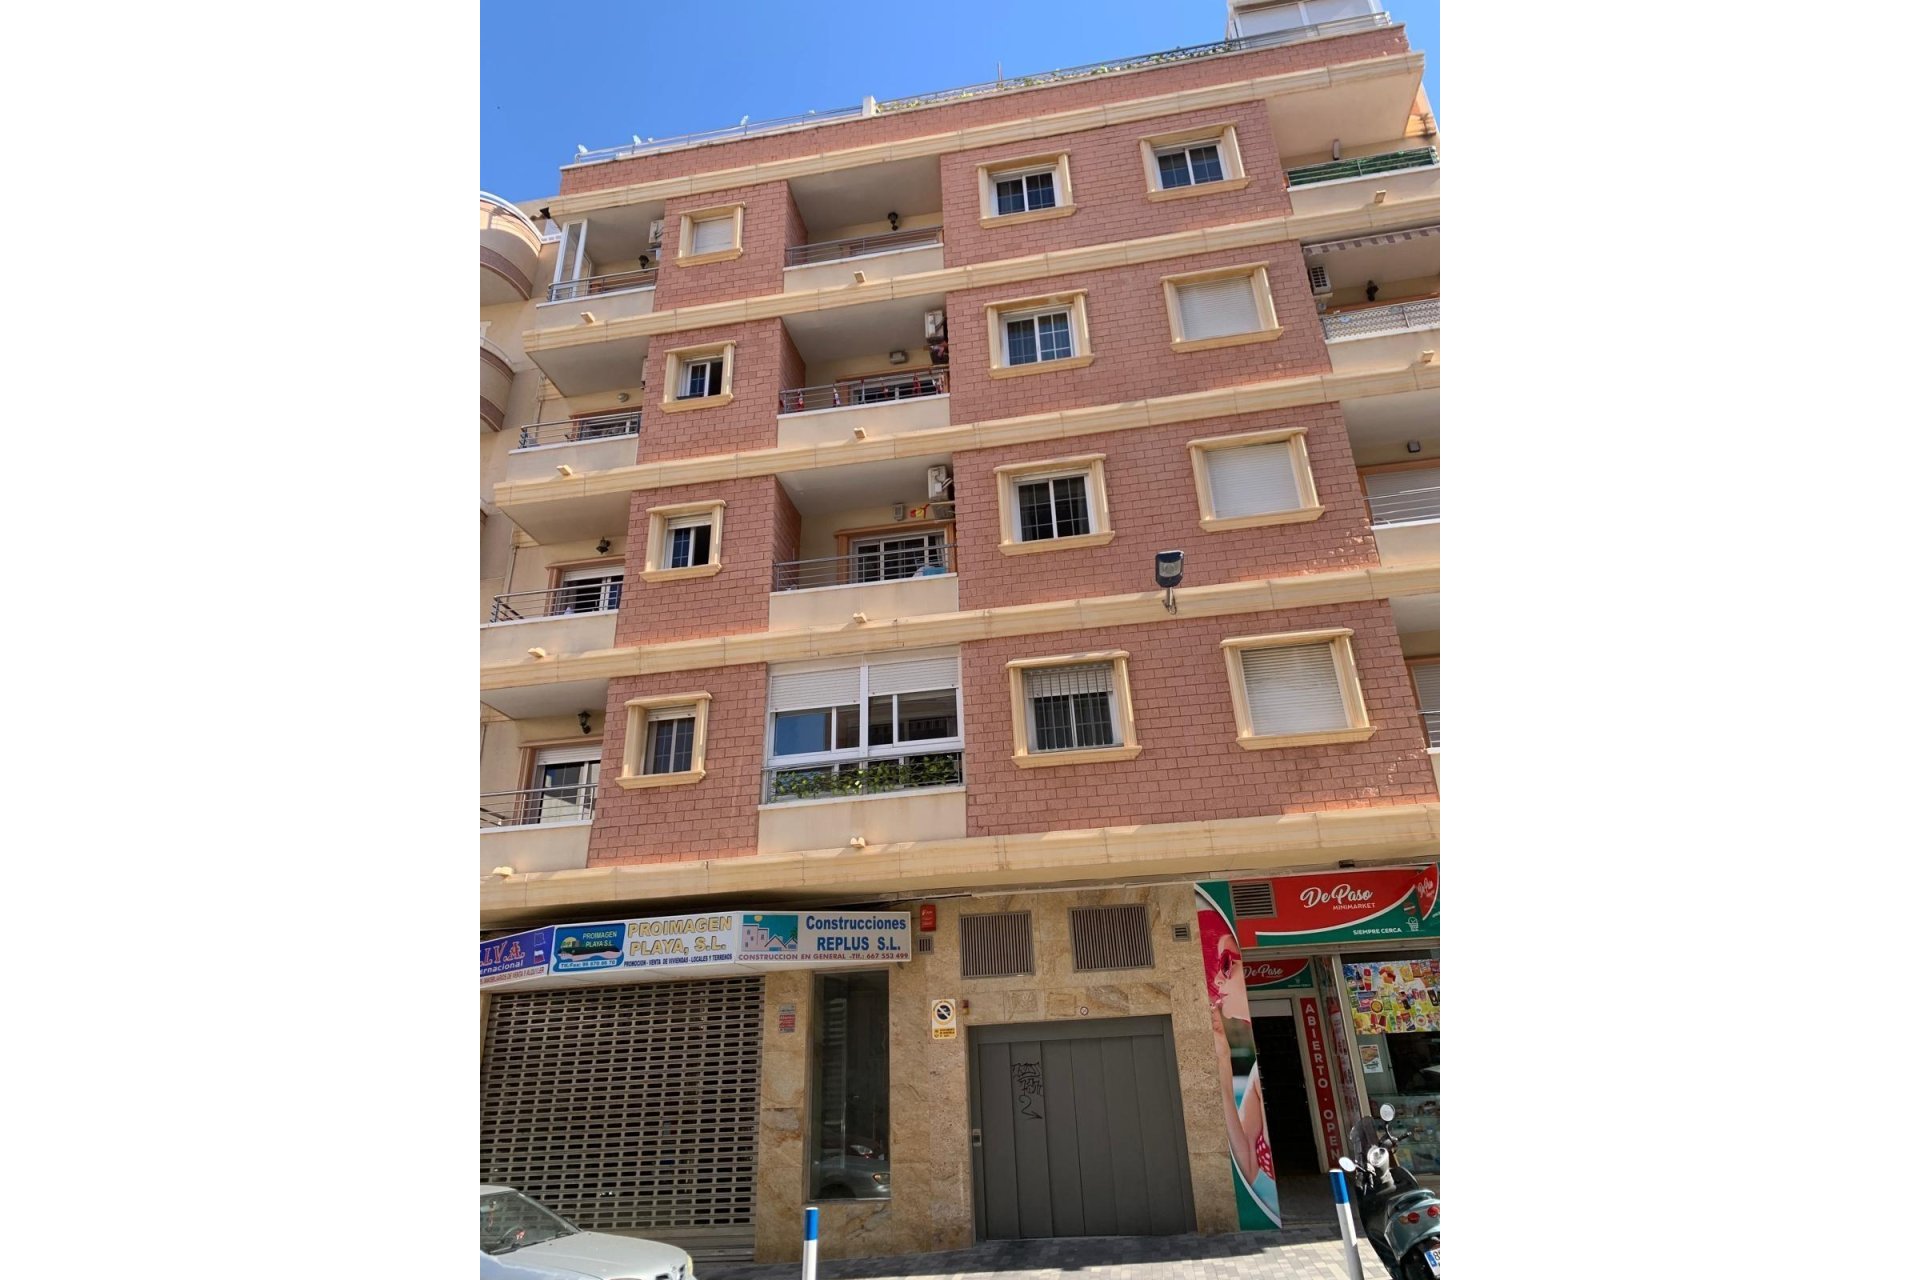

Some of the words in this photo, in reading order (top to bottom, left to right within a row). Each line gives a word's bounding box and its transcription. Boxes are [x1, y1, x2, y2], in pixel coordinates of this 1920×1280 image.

[1300, 887, 1330, 908] De
[1331, 884, 1373, 904] Paso
[1333, 902, 1375, 910] MINIMARKET
[628, 916, 732, 938] PROIMAGEN
[806, 916, 906, 930] Construcciones
[582, 931, 617, 939] PROIMAGEN
[629, 938, 689, 956] PLAYA,
[694, 936, 727, 952] S.L.
[817, 937, 869, 951] REPLUS
[877, 937, 901, 951] S.L.
[691, 955, 708, 963] LOCALES
[738, 953, 798, 961] CONSTRUCCION
[1257, 964, 1283, 977] Paso
[1305, 1004, 1328, 1088] ABIERTO
[1323, 1110, 1340, 1160] OPEN
